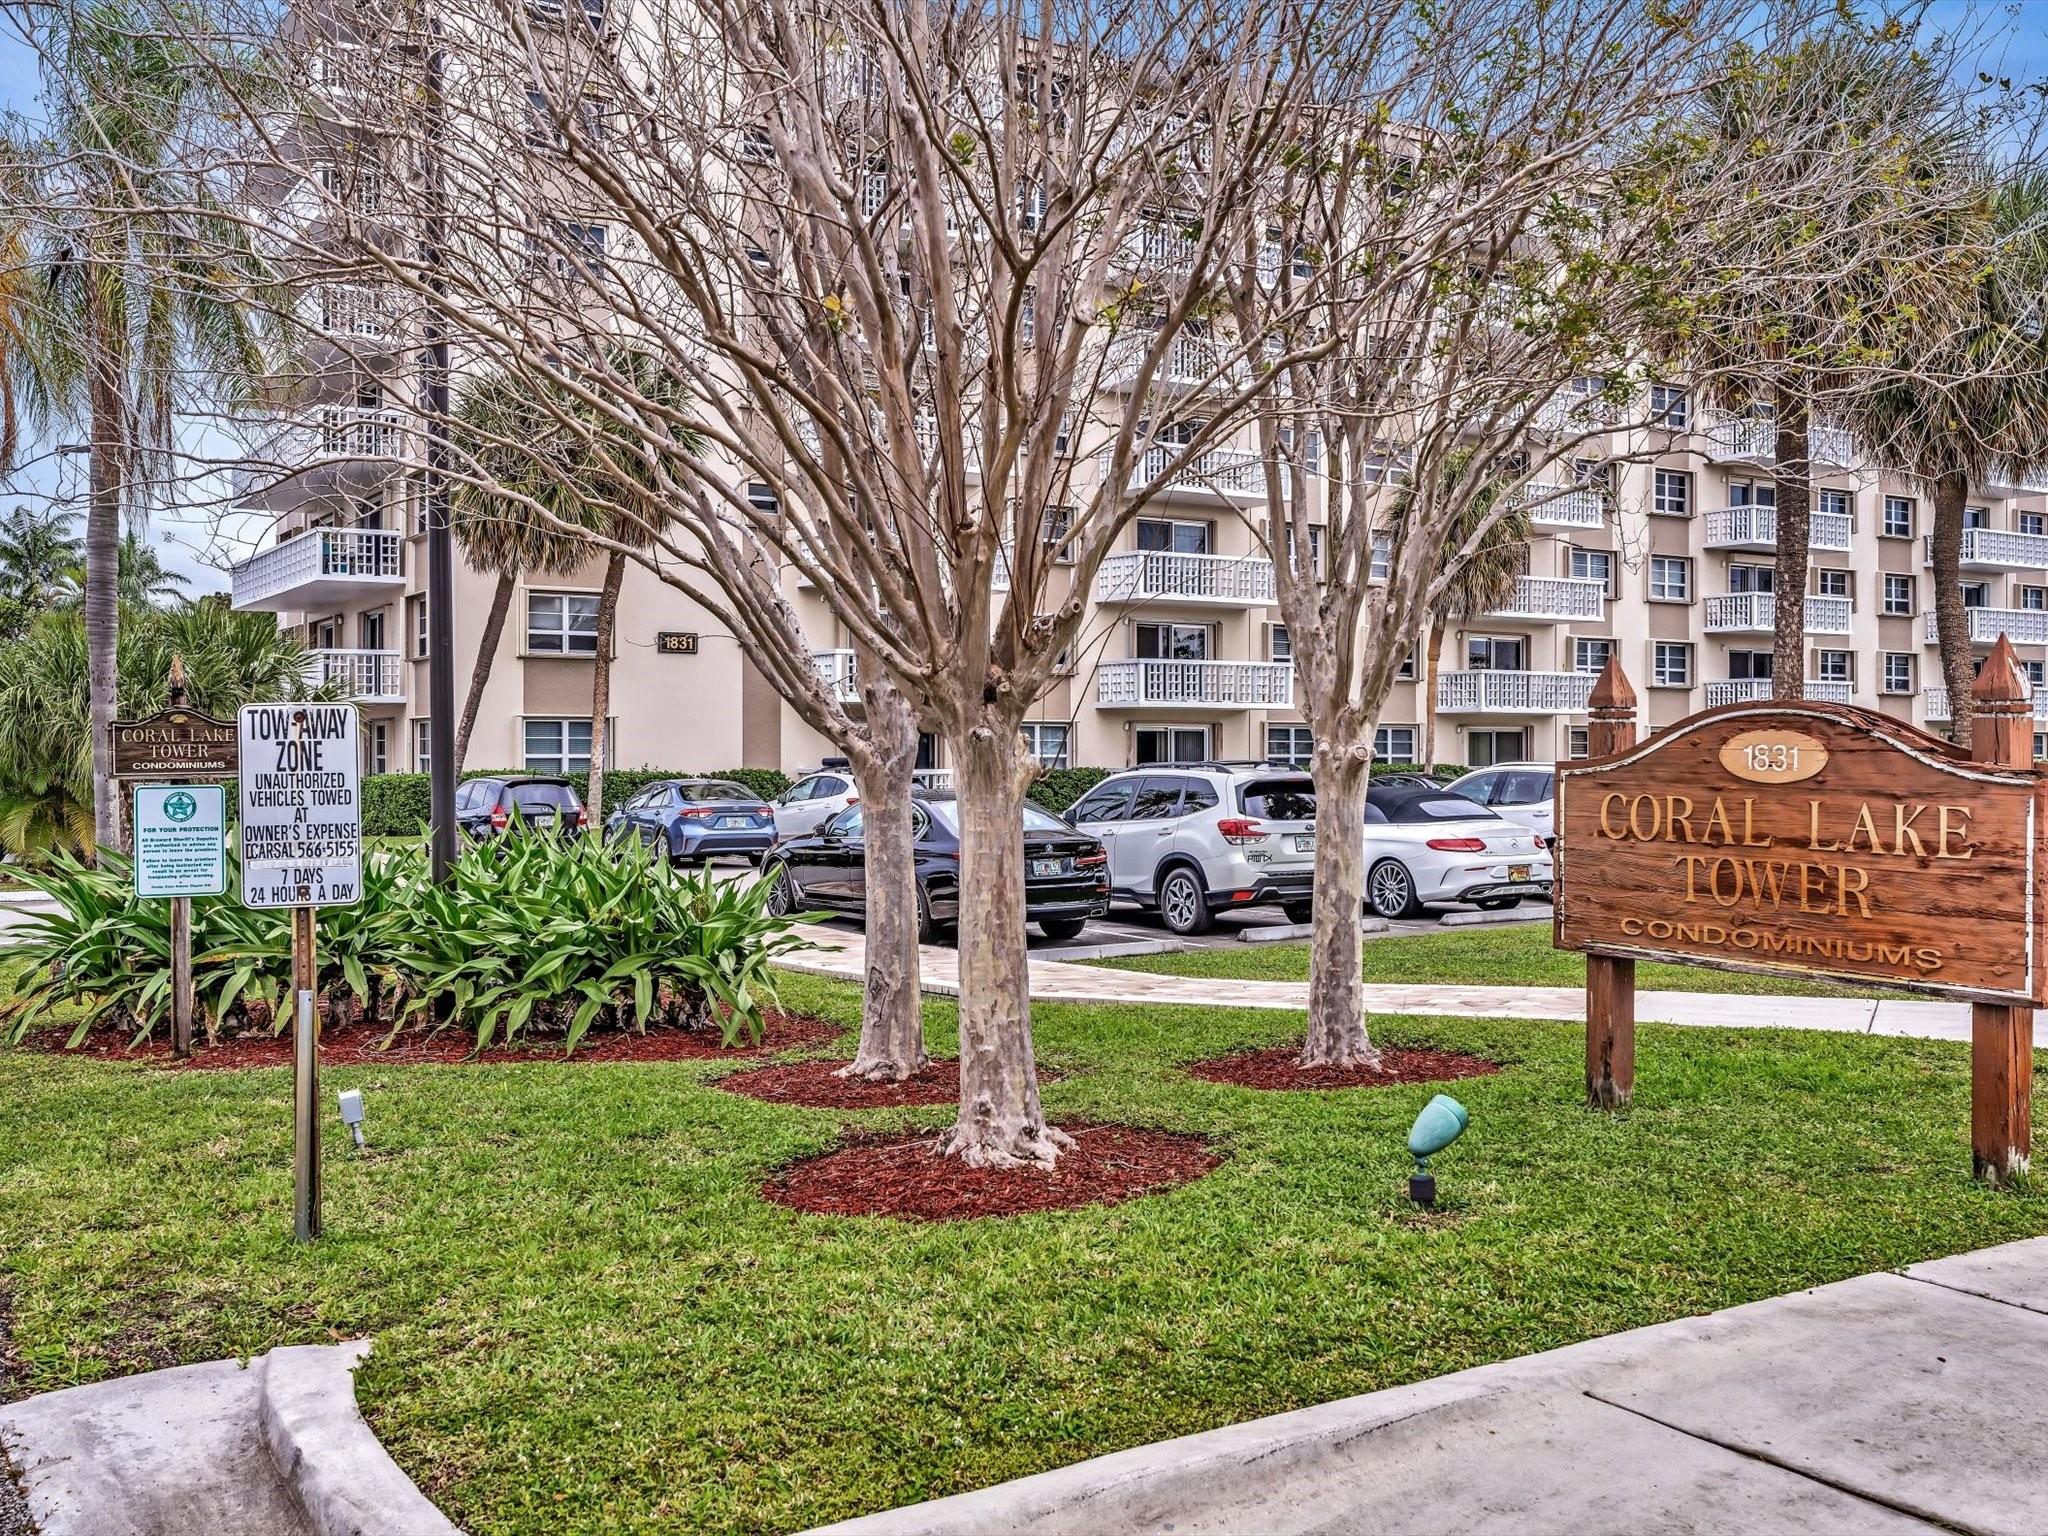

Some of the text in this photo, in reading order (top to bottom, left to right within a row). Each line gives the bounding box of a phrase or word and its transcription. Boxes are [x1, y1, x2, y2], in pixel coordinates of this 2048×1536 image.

[666, 637, 692, 649] 1831
[248, 709, 347, 740] TOW-AWAY
[122, 729, 234, 742] CORAL LAKE
[149, 744, 208, 757] TOWER
[276, 741, 323, 772] ZONE
[1743, 744, 1799, 771] 1831
[256, 773, 344, 789] UNAUTHORIZED
[249, 790, 351, 807] VEHICLES TOWED
[294, 808, 308, 823] AT
[245, 823, 357, 841] OWNER'S EXPENSE
[1600, 793, 1973, 859] CORAL LAKE
[298, 841, 354, 858] 566-5155
[282, 868, 323, 884] 7 DAYS
[251, 887, 265, 903] 24
[318, 885, 326, 900] A
[333, 884, 353, 899] DAY
[1675, 856, 1871, 918] TOWER
[1621, 917, 1944, 969] CONDOMINIUMS
